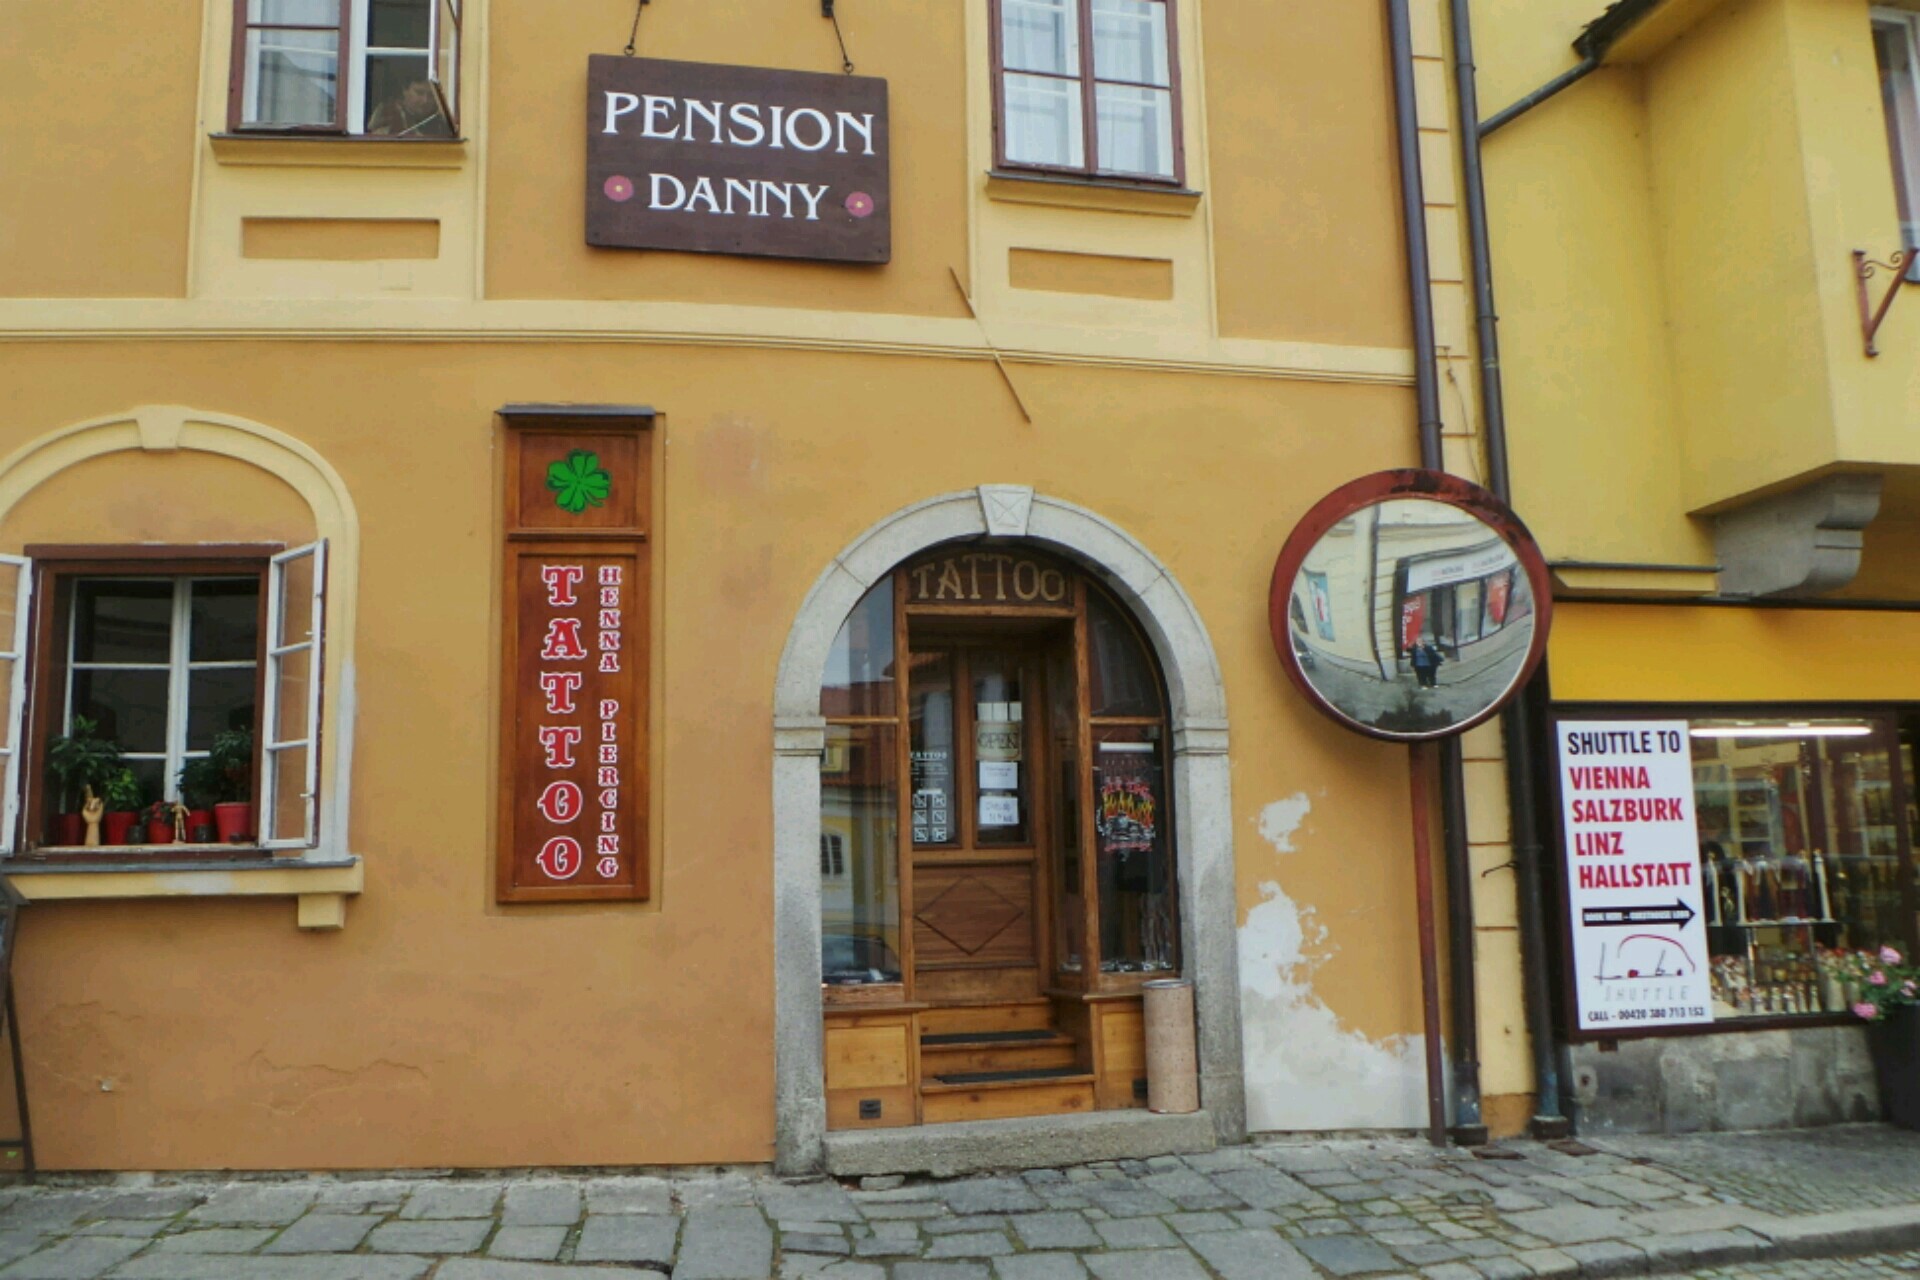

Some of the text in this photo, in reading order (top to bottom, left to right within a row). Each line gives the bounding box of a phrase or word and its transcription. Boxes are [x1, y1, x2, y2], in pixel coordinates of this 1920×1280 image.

[602, 90, 875, 155] PENSION
[648, 172, 830, 219] DANNY
[912, 552, 1065, 601] TATTOO
[537, 565, 586, 880] TATTOO
[597, 565, 621, 877] HENNA PIERCING
[1568, 730, 1681, 755] SHUTTLE TO
[1569, 766, 1651, 790] VIENNA
[1572, 798, 1684, 823] SALZBURK
[1575, 832, 1624, 856] LINZ
[1578, 863, 1692, 889] HALLSTATT
[1588, 1011, 1609, 1021] CALL
